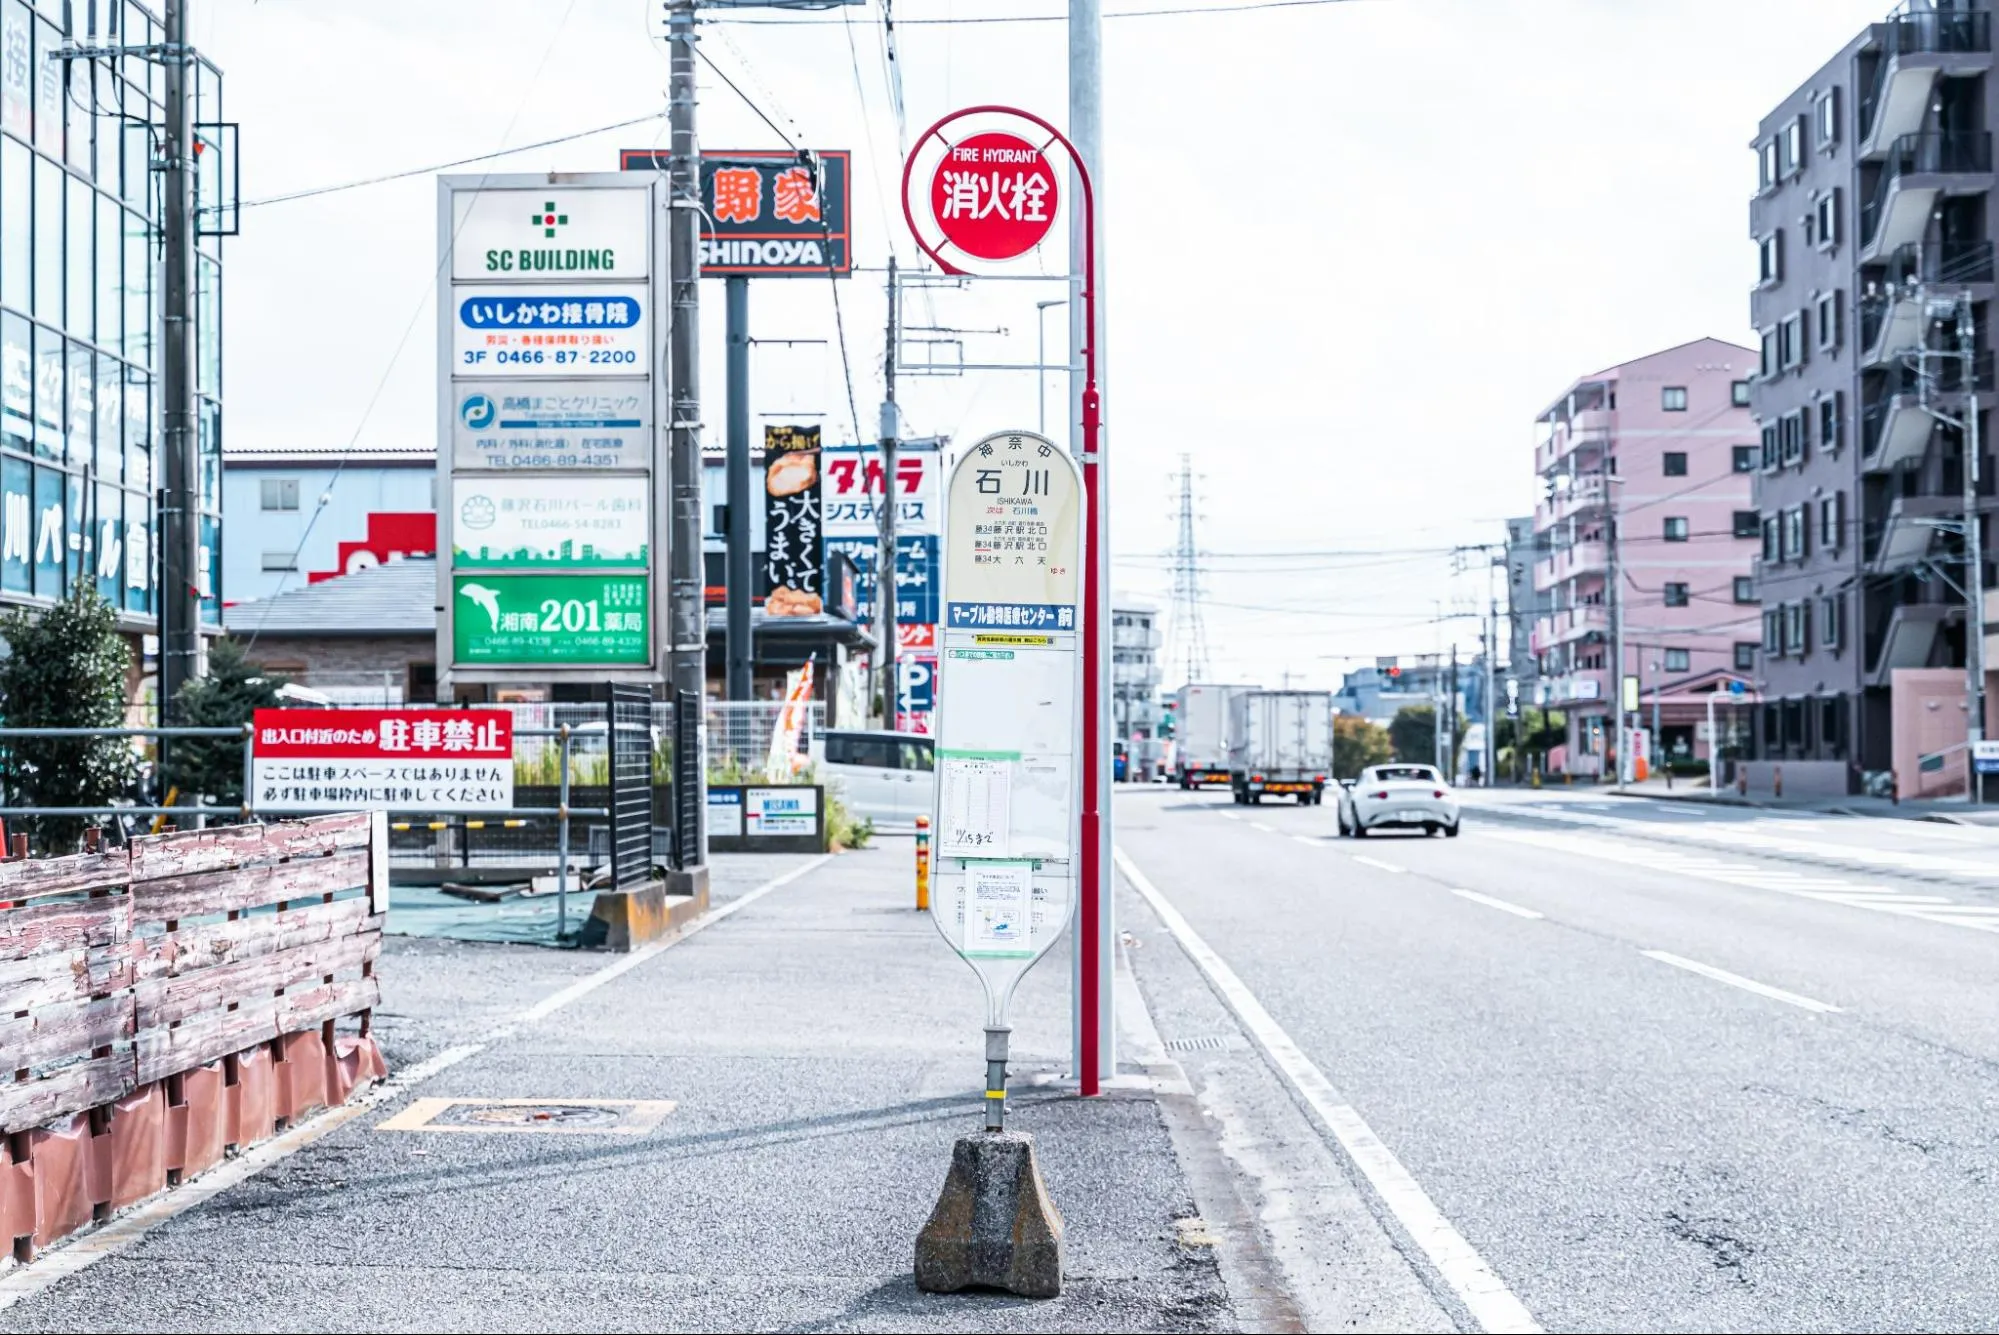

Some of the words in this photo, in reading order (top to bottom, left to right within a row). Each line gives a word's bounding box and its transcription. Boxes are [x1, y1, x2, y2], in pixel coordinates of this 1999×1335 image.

[953, 148, 979, 162] FIRE
[983, 149, 1037, 163] HYDRANT
[713, 167, 821, 224] 野家
[942, 170, 1050, 221] 消火栓
[486, 250, 513, 271] SC
[519, 249, 614, 271] BUILDING
[472, 302, 628, 324] いしかわ接骨院
[464, 351, 486, 363] 3F
[497, 350, 636, 363] 0466-87-2200
[503, 396, 639, 411] 高橋まことクリニック
[978, 436, 1052, 459] 神奈中
[828, 459, 923, 494] タカラ
[975, 469, 1048, 495] 石川
[997, 497, 1033, 505] ISHIKAWA
[789, 490, 820, 592] 大きくて
[993, 526, 1047, 535] 藤沢駅北口
[993, 541, 1047, 550] 藤沢駅北口
[993, 556, 1047, 565] 大六天
[500, 599, 642, 632] 湘南201薬局
[953, 605, 1055, 625] マーブル動物医療センター
[1058, 607, 1073, 627] 前
[899, 663, 929, 695] P
[261, 728, 376, 744] 出入口付近のため
[378, 718, 506, 751] 駐車禁止
[263, 767, 503, 781] ここは駐車スペースではありません
[263, 787, 504, 801] 必ず駐車場枠内に駐車してください
